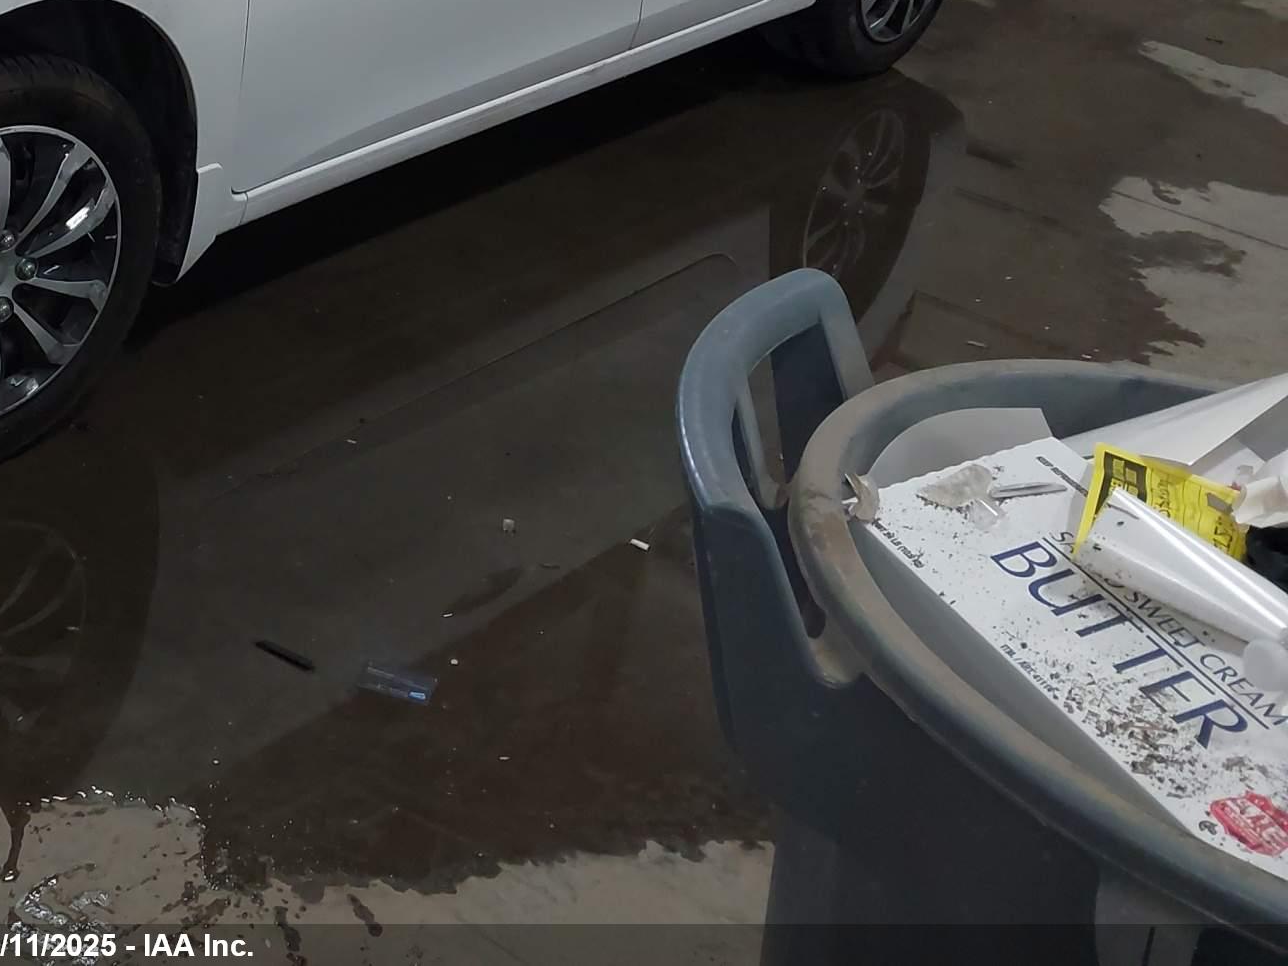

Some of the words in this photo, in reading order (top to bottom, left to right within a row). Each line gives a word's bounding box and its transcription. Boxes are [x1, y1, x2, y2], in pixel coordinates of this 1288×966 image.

[990, 541, 1249, 749] BUTTER
[1124, 591, 1206, 648] SWEET
[1200, 654, 1288, 726] CREAM
